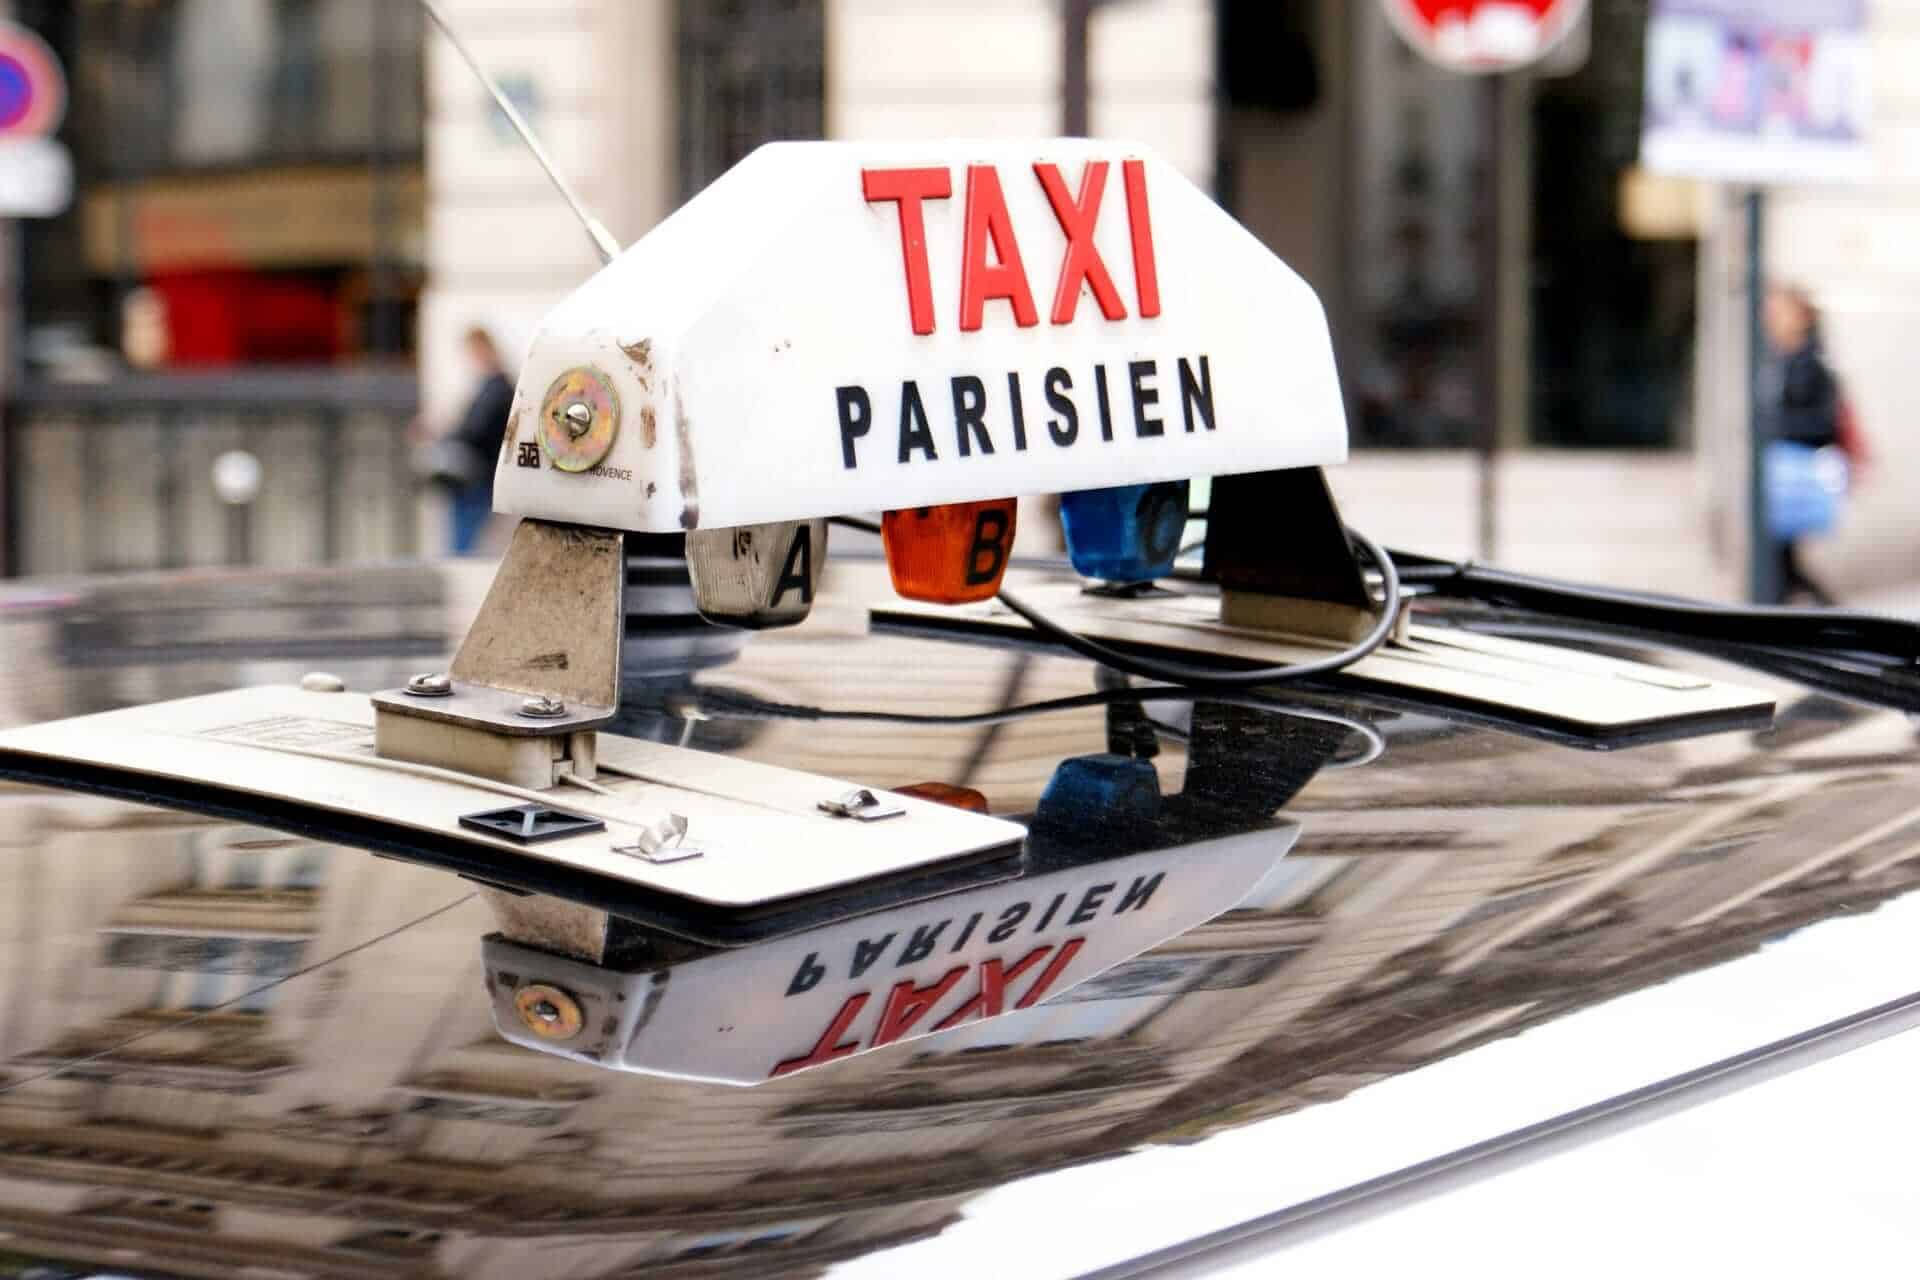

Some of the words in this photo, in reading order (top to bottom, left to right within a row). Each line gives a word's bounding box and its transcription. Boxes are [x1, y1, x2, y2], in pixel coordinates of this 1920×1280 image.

[862, 159, 1161, 336] TAXI
[835, 355, 1217, 469] PARISIEN
[769, 525, 812, 608] A
[966, 508, 1009, 586] B
